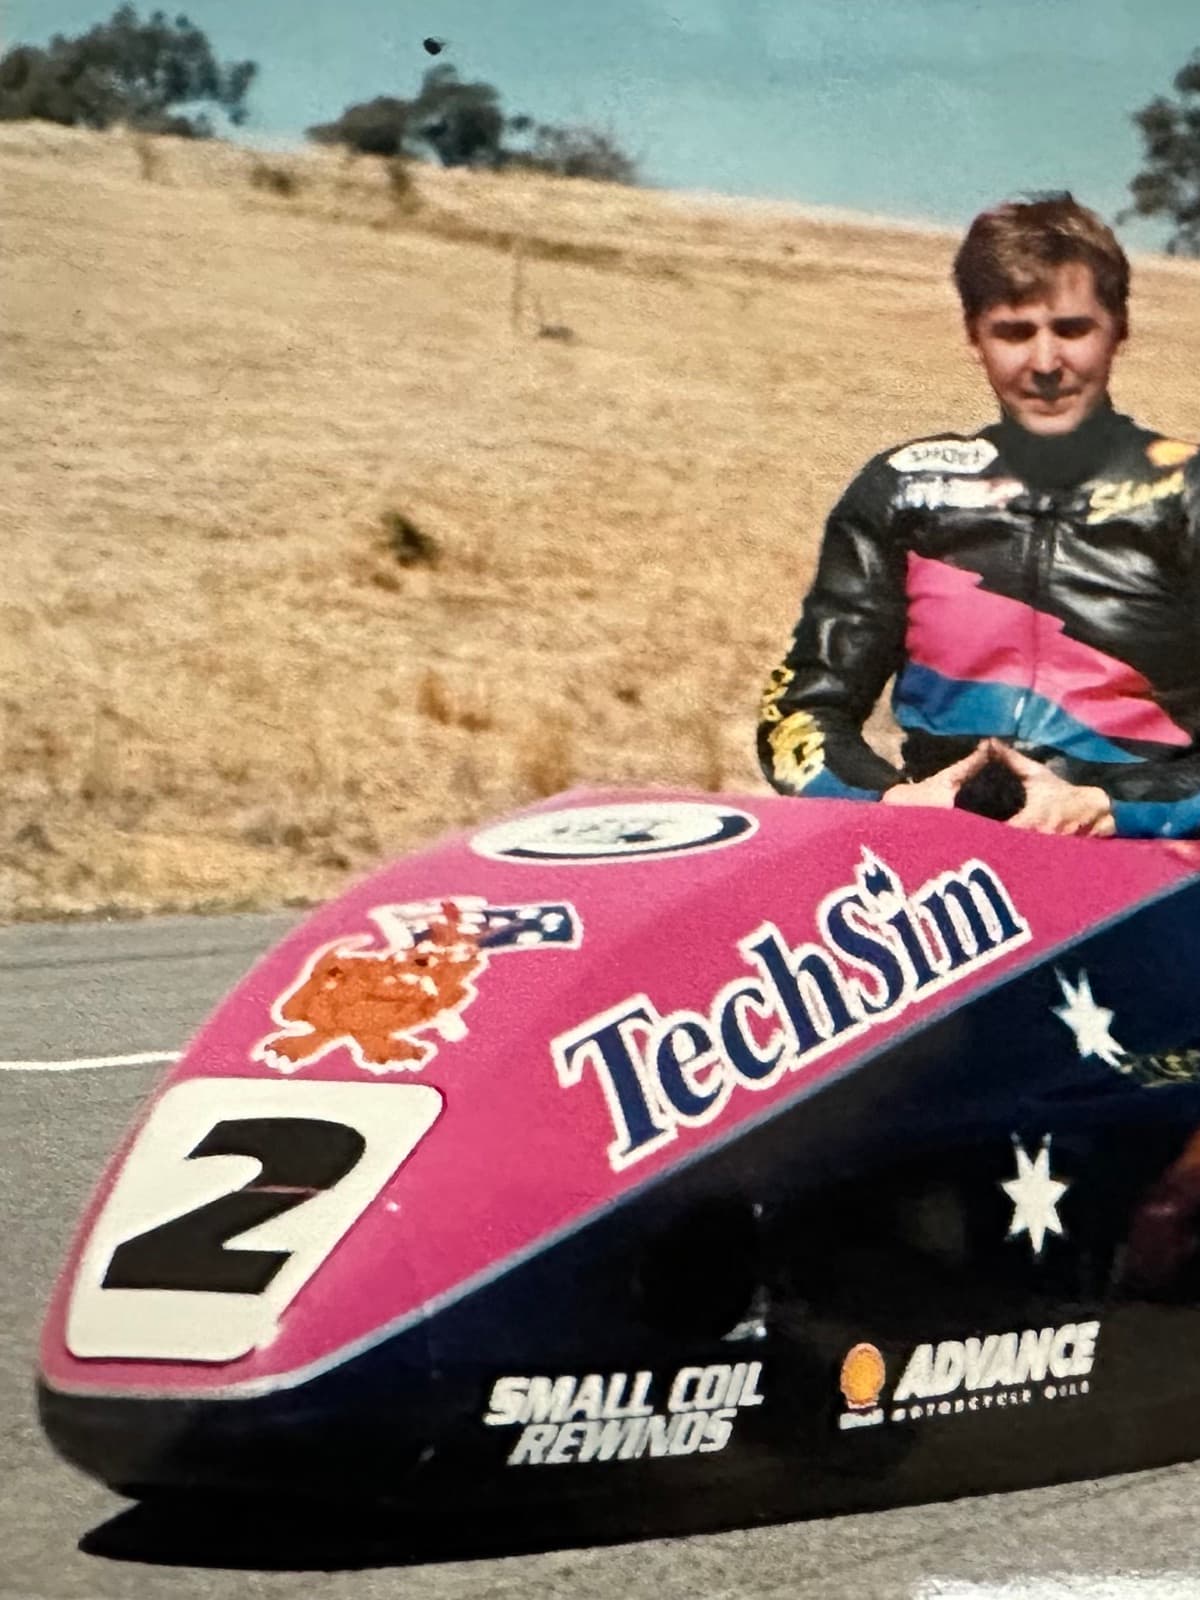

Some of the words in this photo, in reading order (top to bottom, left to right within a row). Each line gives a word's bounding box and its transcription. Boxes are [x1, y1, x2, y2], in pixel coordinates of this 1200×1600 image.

[553, 848, 1030, 1170] TechSim
[102, 1116, 367, 1295] 2
[483, 1370, 654, 1426] SMALL
[668, 1361, 765, 1413] COIL
[893, 1321, 1100, 1401] ADVANCE
[506, 1407, 738, 1467] REWINDS
